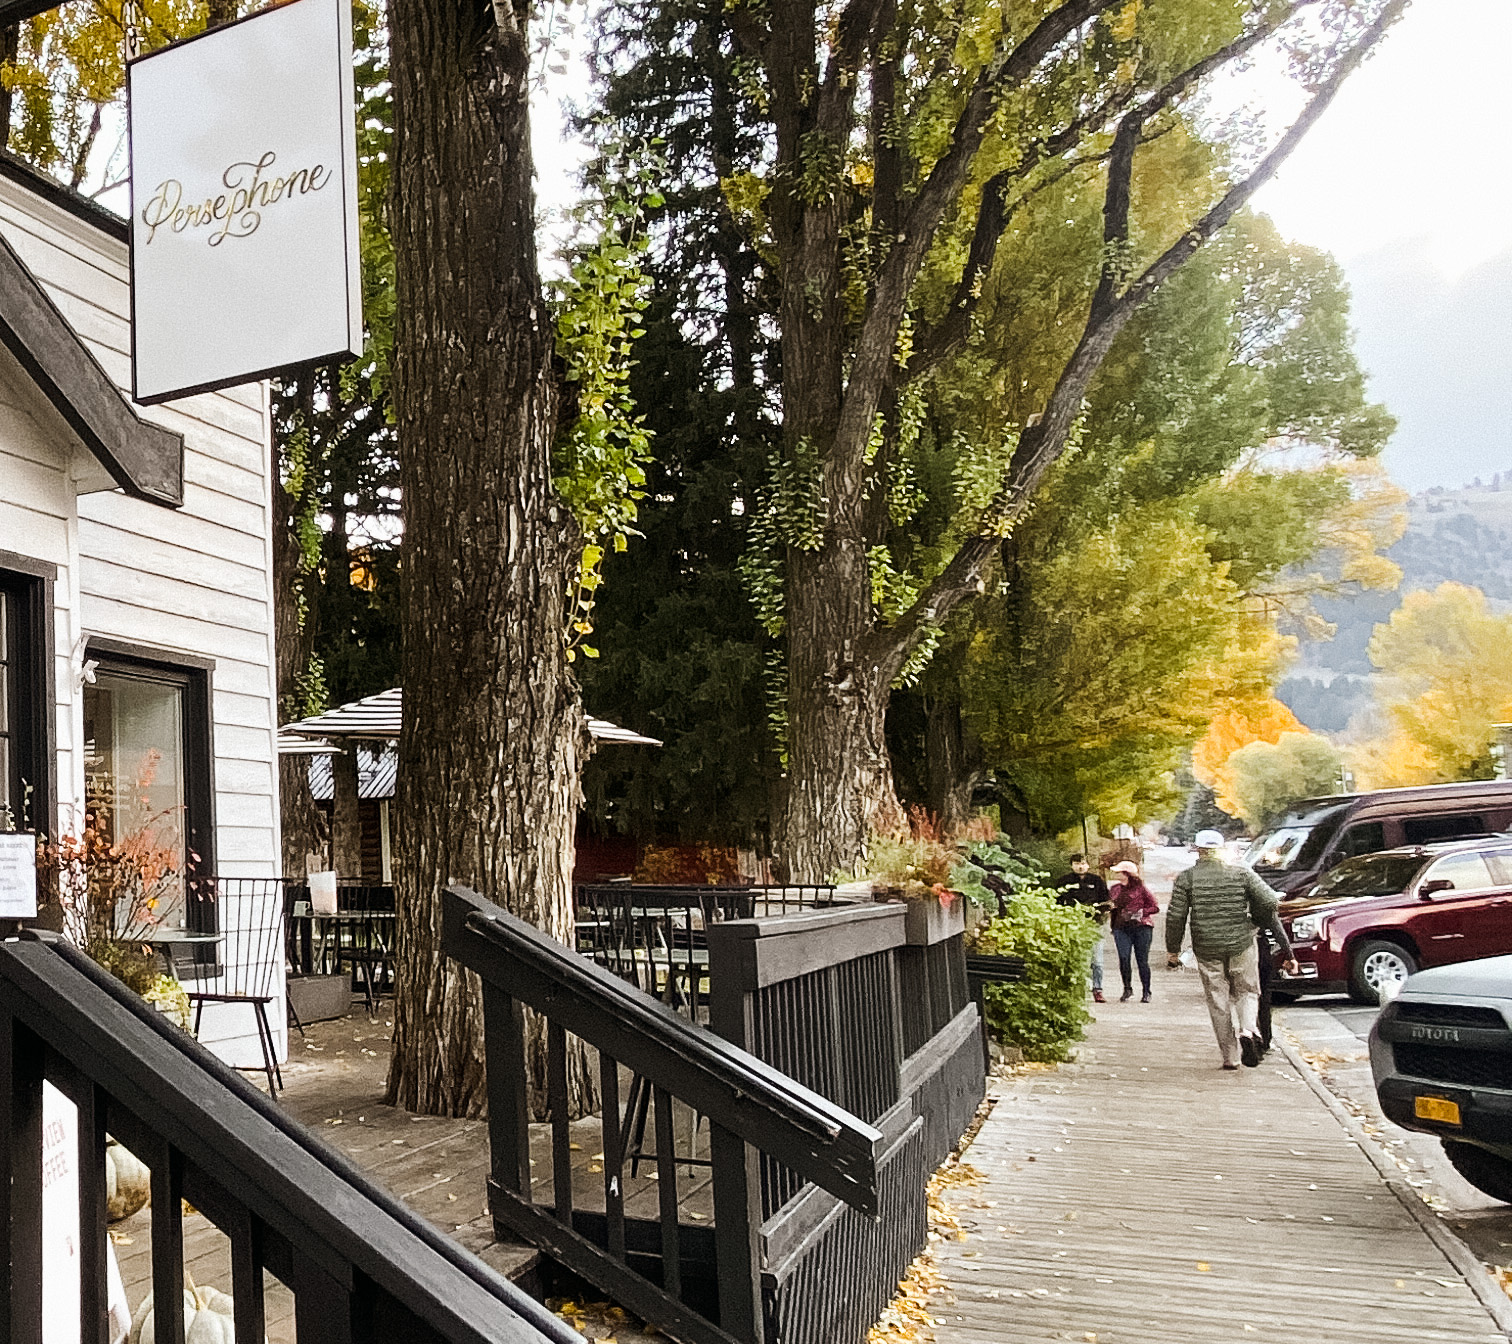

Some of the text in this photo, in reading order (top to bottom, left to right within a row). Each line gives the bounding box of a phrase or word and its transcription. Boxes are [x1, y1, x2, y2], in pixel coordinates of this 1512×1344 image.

[142, 151, 332, 246] Persephone
[1412, 1027, 1459, 1041] TOYOTA
[43, 1119, 65, 1149] VIEW
[43, 1151, 69, 1188] FFEE
